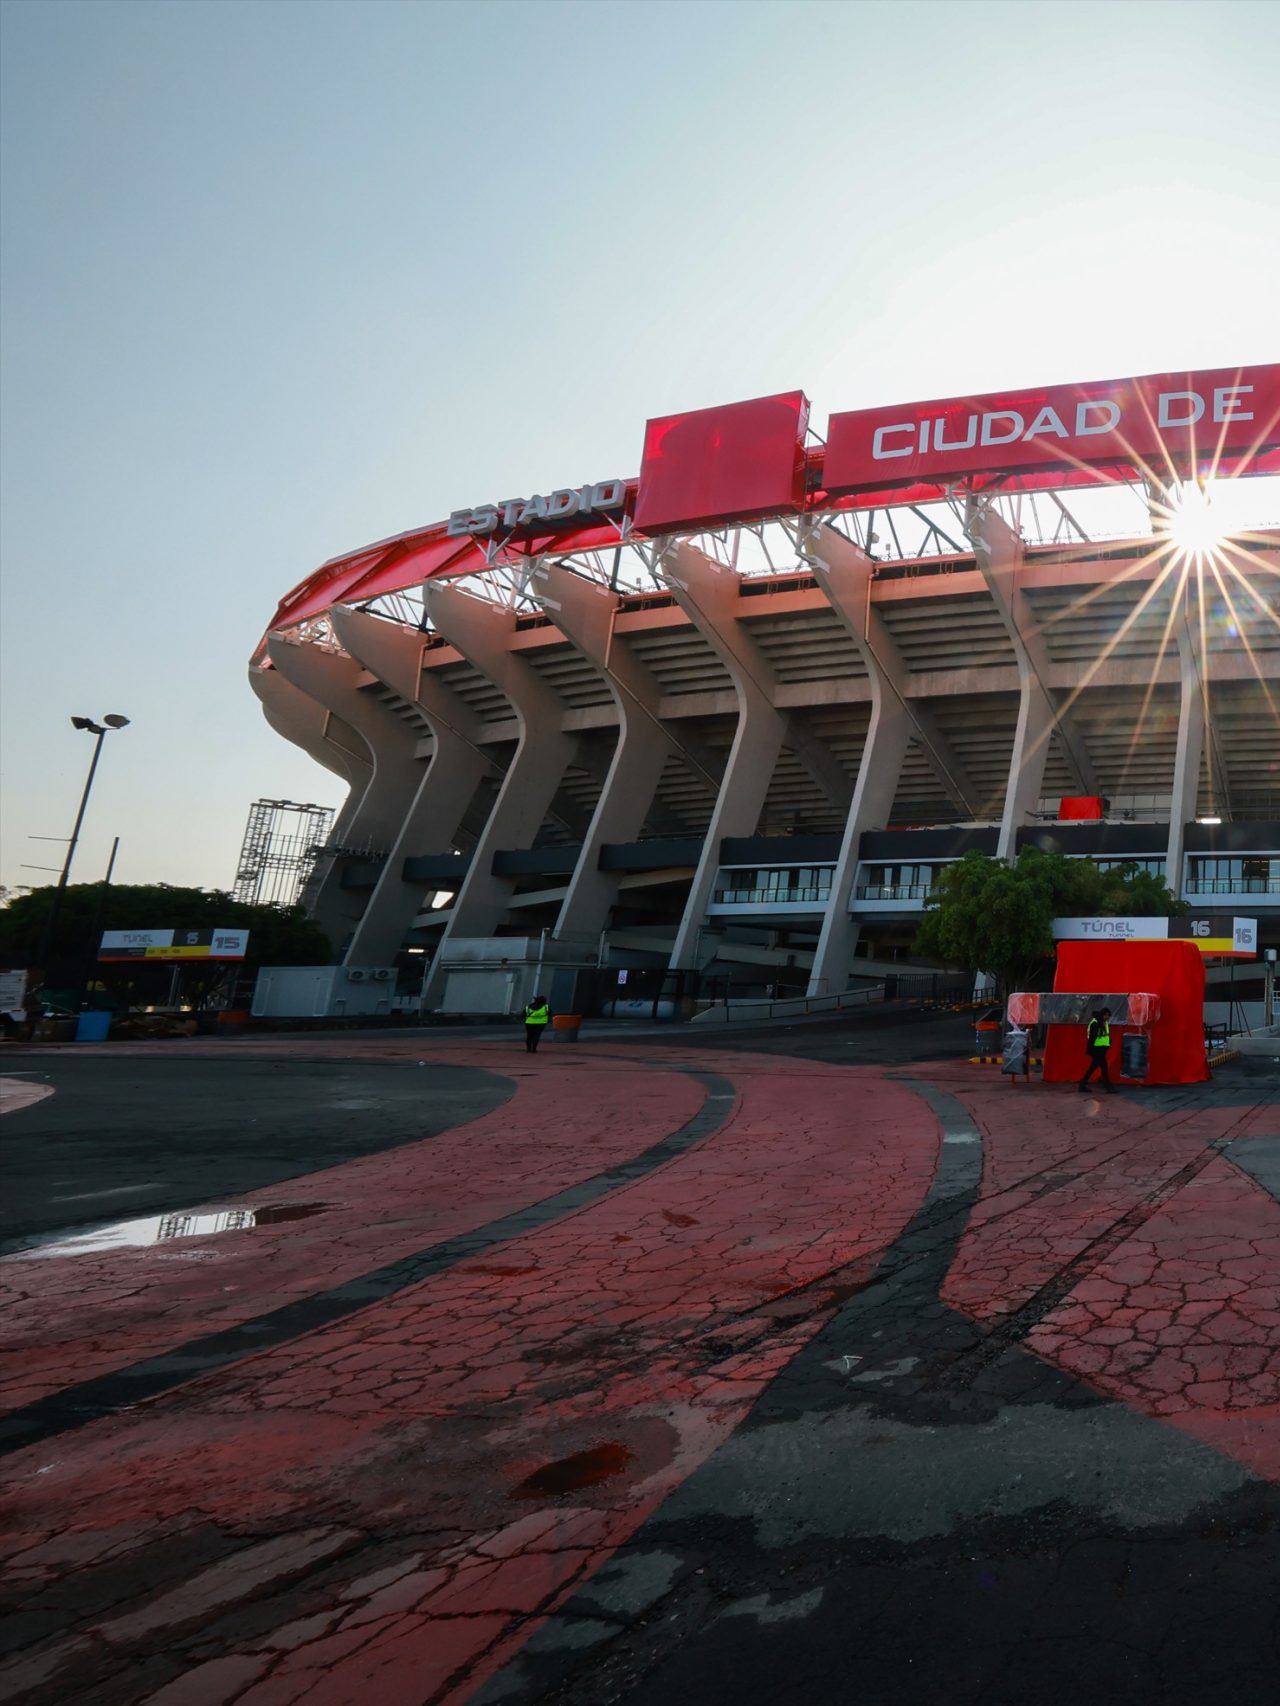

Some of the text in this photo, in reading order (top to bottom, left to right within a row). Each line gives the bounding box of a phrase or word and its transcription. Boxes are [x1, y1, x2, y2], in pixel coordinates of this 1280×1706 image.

[871, 400, 1121, 461] CIUDAD
[1157, 384, 1255, 428] DE
[447, 478, 626, 536] ESTADIO
[1081, 919, 1135, 933] TÚNEL
[1190, 920, 1211, 936] 16
[215, 937, 240, 949] 15
[1235, 928, 1252, 944] 16
